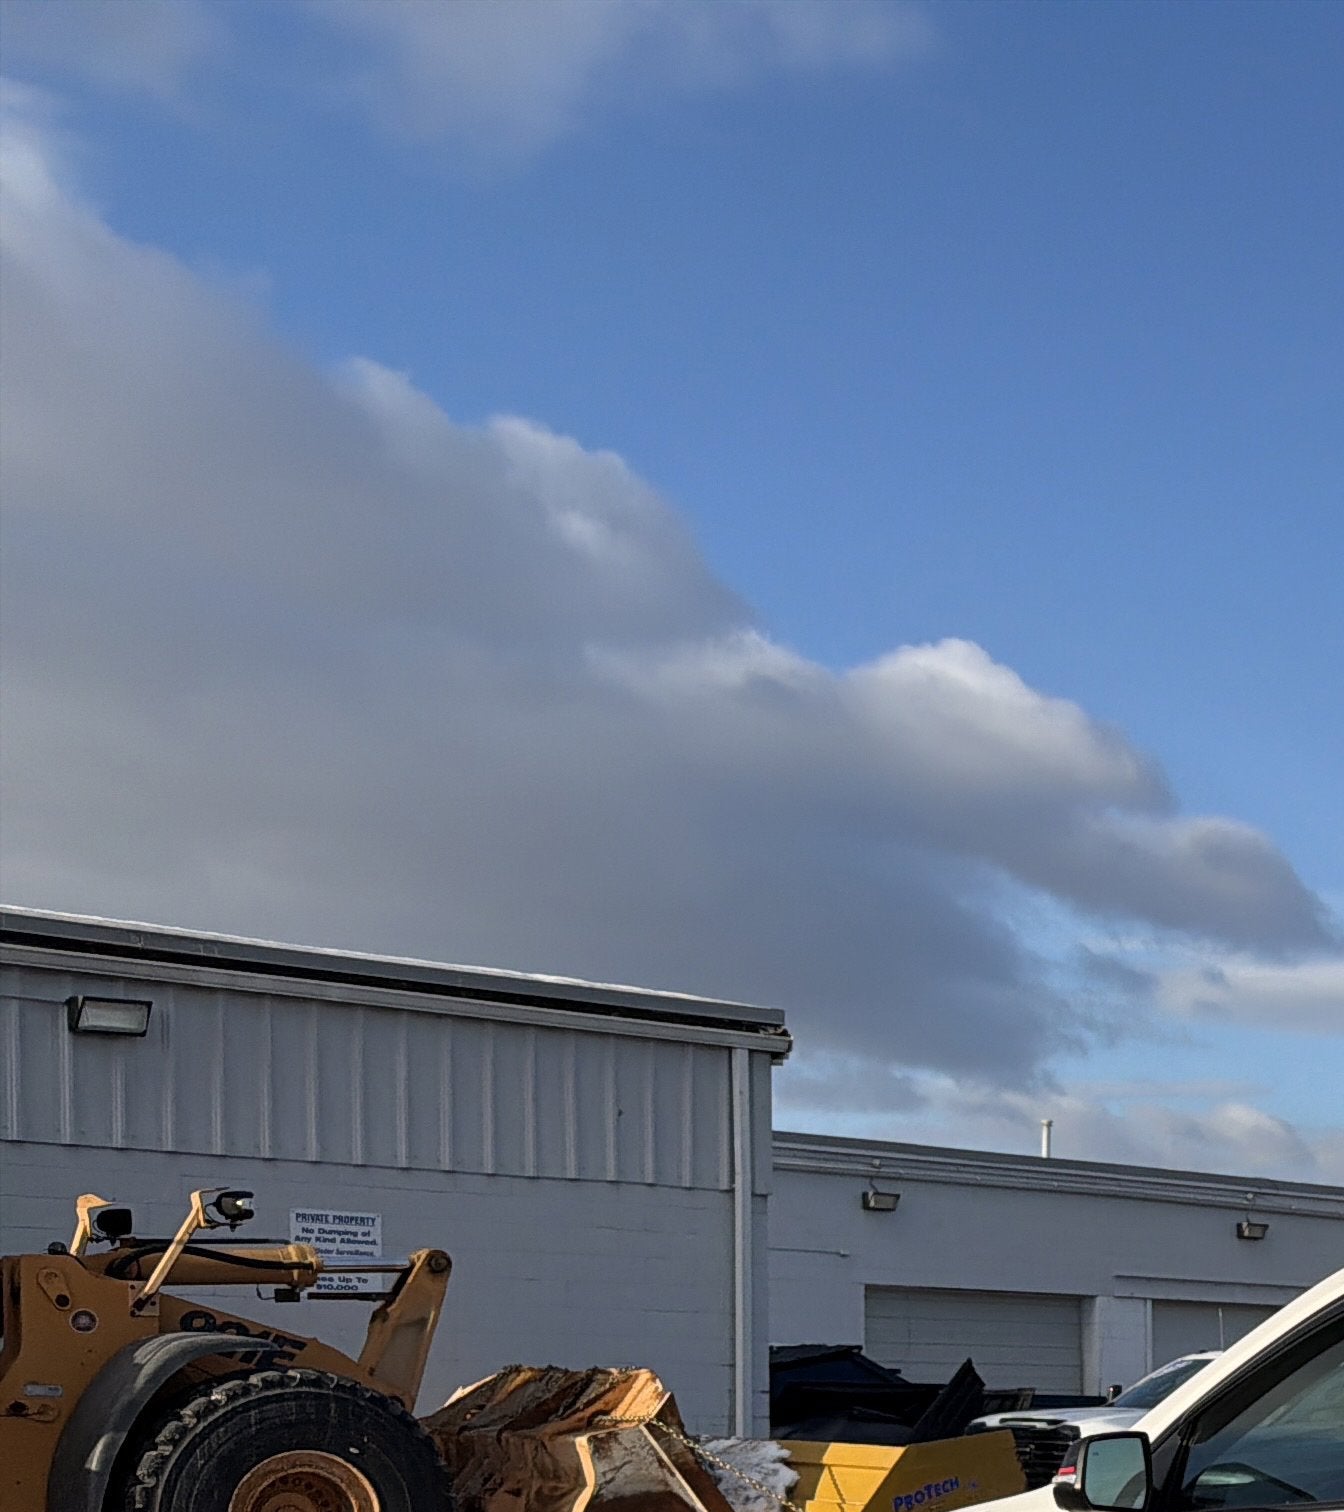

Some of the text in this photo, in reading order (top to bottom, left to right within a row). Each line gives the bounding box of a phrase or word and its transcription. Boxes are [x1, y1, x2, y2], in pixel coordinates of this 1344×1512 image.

[295, 1212, 377, 1227] PRIVATE PROPERTY
[301, 1227, 315, 1235] No
[317, 1228, 359, 1237] Dumping
[295, 1235, 312, 1243] Any
[314, 1236, 337, 1244] Kind
[337, 1276, 353, 1284] Up
[355, 1276, 369, 1284] To
